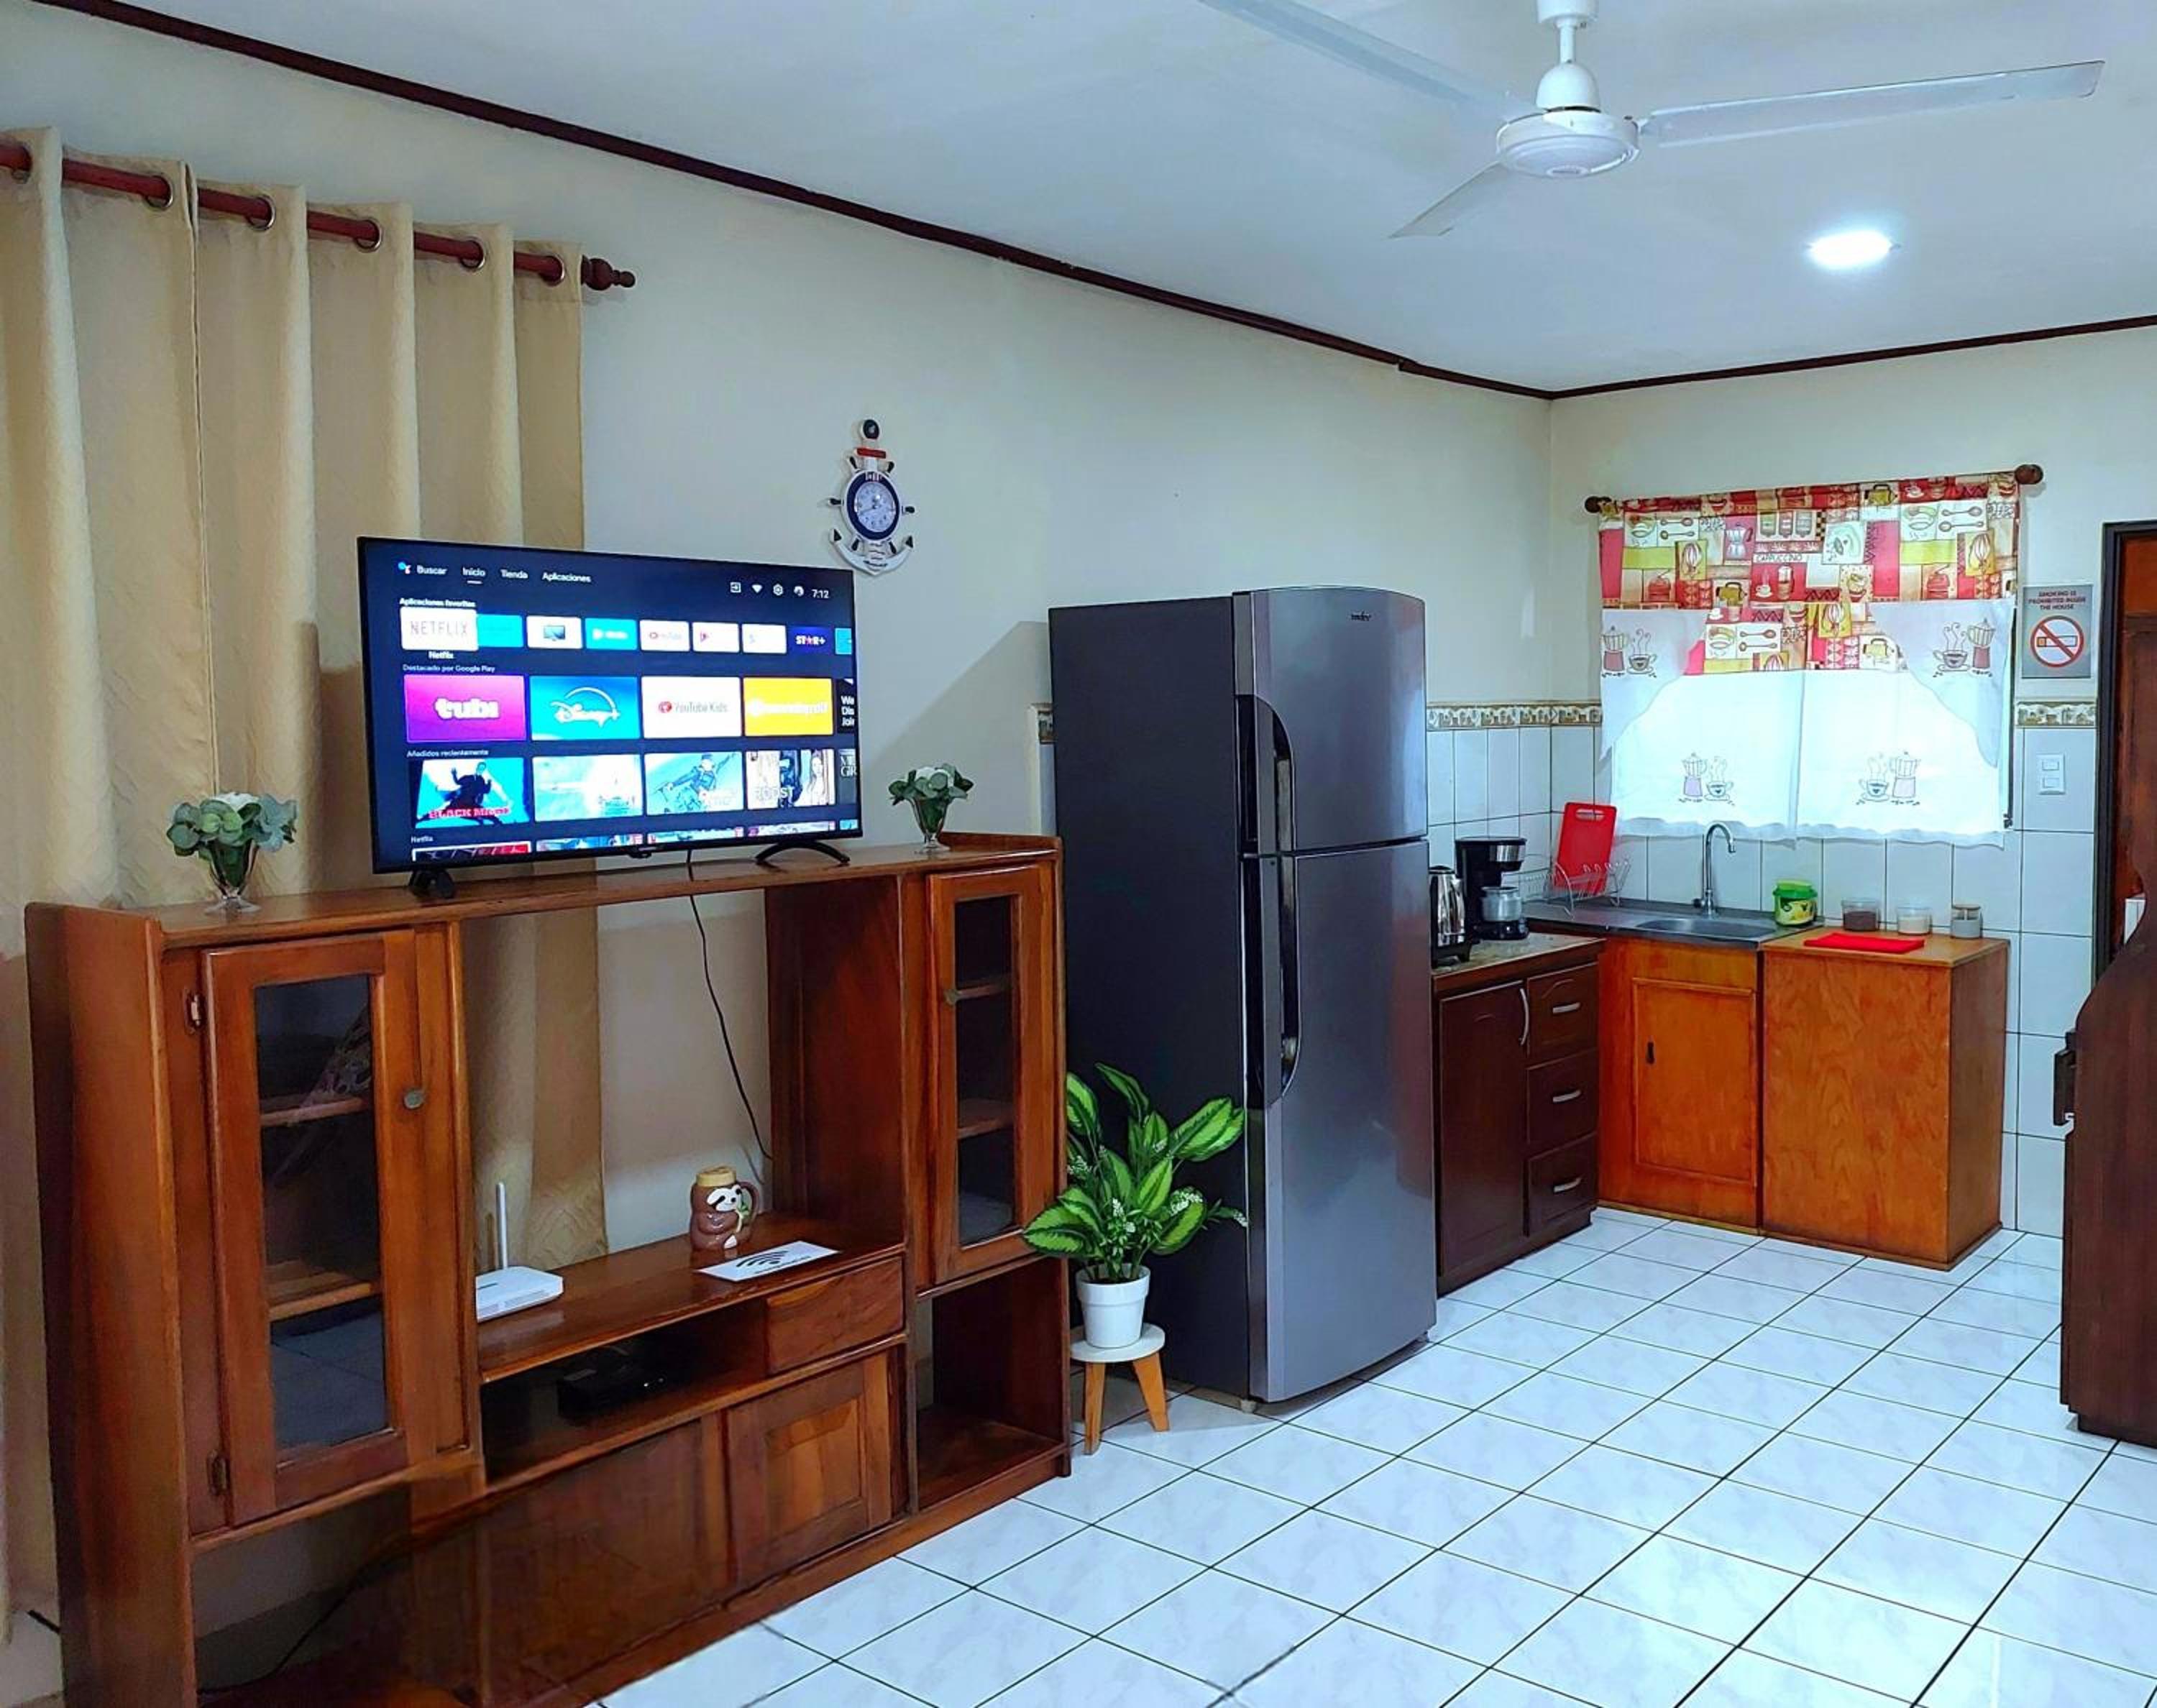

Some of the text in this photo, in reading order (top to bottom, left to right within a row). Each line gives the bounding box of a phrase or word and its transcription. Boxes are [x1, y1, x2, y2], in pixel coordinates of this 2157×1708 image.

[416, 564, 592, 583] Buscar Inicio Tienda Aplicaciones
[812, 589, 830, 600] 7:12
[399, 597, 476, 608] Aplicaciones favoritas
[410, 620, 467, 638] NETFLIX
[429, 651, 454, 659] Netflix
[403, 664, 441, 672] Destacado
[455, 665, 480, 674] Google
[481, 665, 496, 674] Play
[407, 748, 489, 758] Añadidos recientemente
